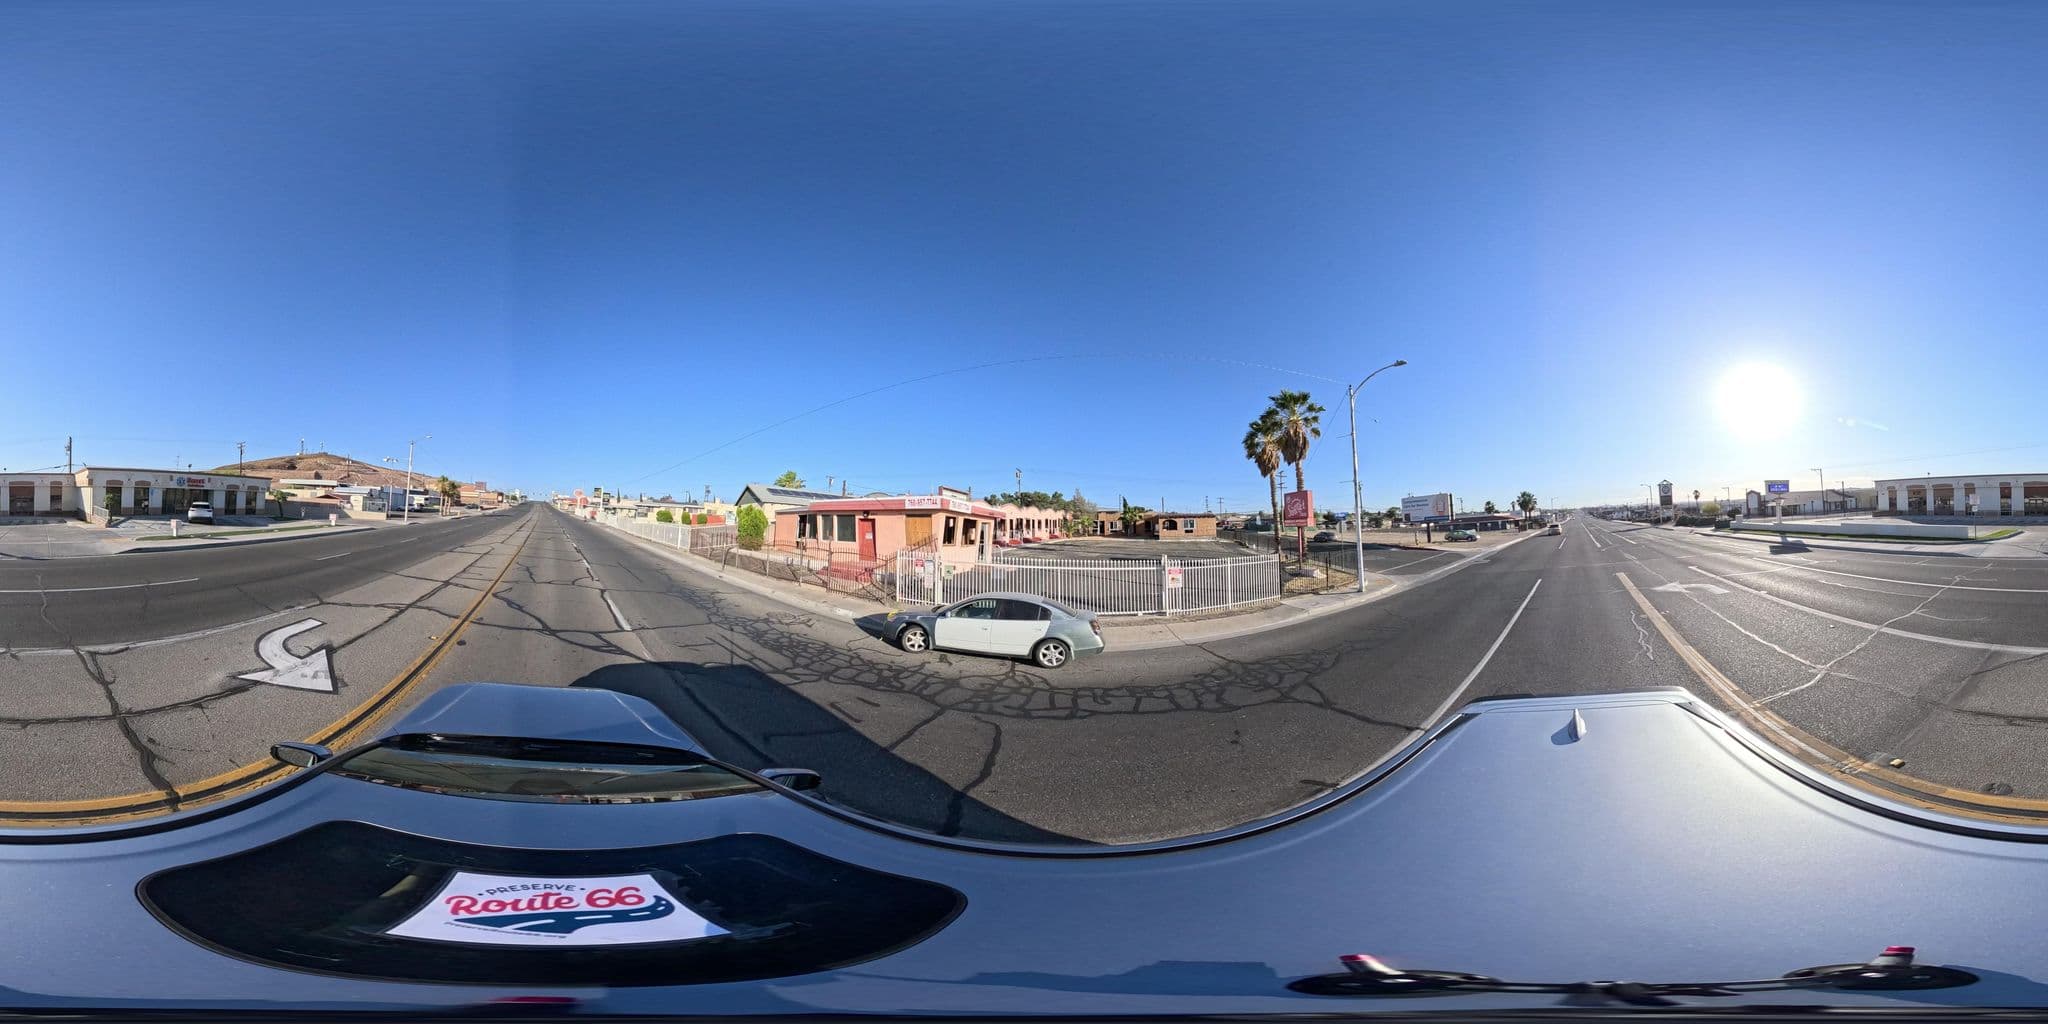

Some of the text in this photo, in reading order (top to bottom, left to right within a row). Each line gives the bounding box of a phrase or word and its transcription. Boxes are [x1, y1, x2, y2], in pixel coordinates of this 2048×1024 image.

[486, 883, 577, 896] PRESERVE
[445, 886, 645, 915] Route 66
